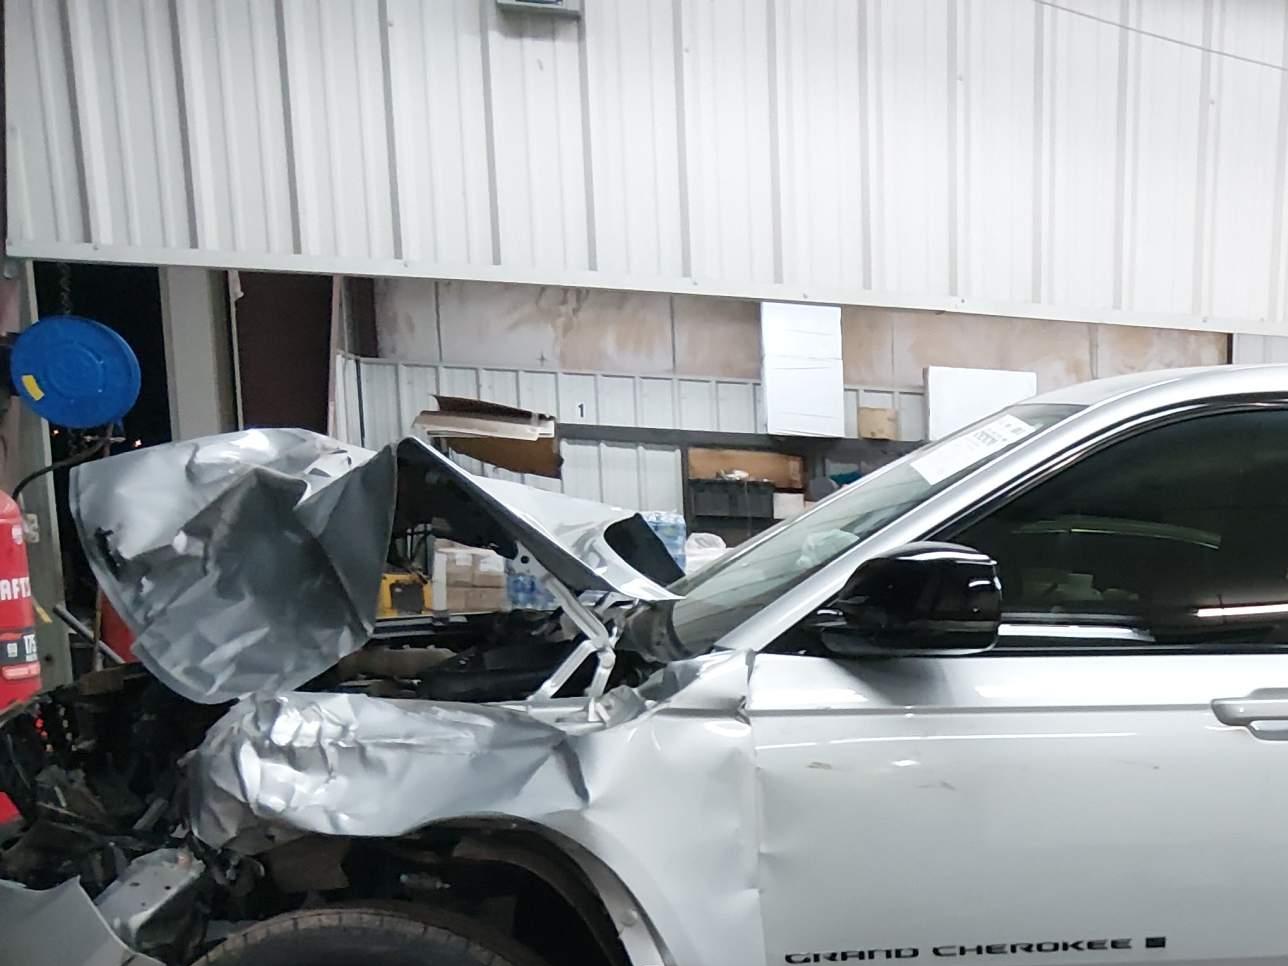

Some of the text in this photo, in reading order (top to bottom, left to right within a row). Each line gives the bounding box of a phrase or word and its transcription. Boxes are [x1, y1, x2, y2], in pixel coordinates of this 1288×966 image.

[578, 403, 584, 418] 1
[0, 576, 31, 600] AFT
[784, 938, 1132, 965] GRAND CHEROKEE
